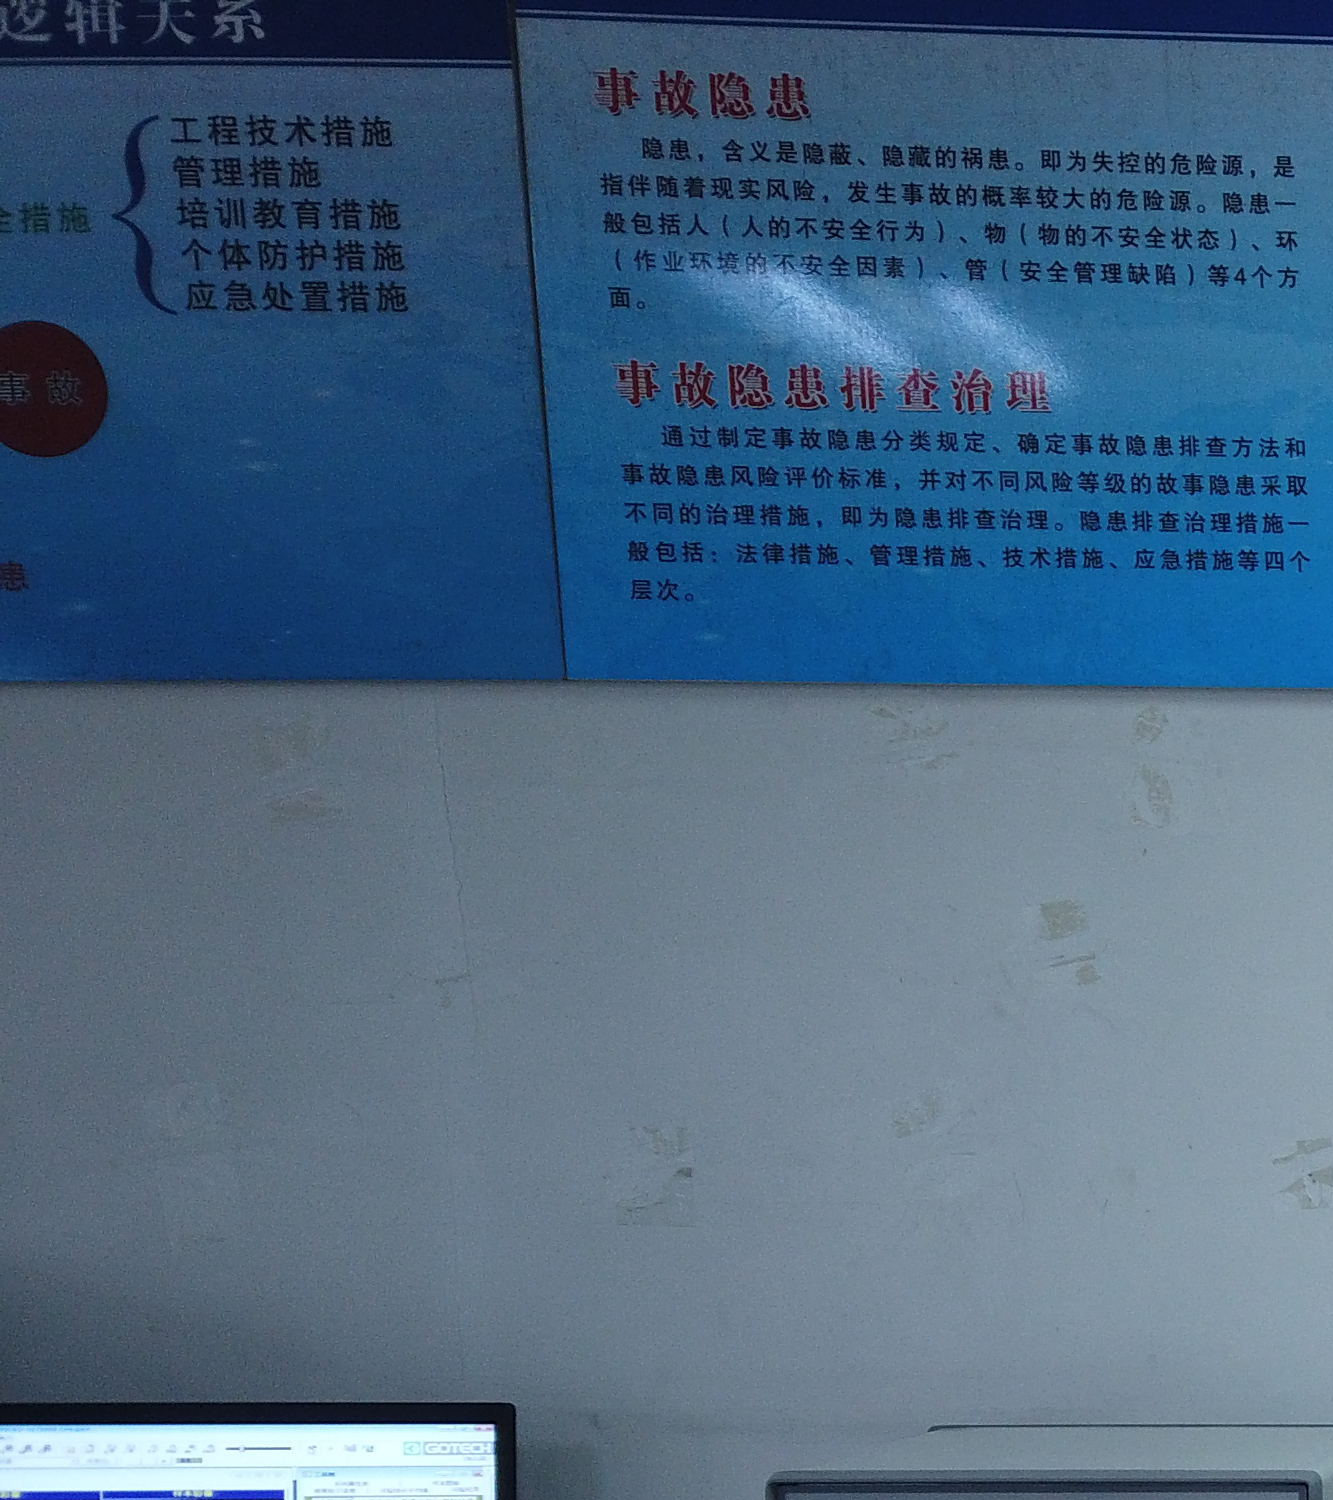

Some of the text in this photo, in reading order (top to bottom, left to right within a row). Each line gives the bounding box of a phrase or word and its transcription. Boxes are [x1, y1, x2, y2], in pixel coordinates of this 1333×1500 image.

[593, 66, 812, 121] 事故隐患
[171, 114, 394, 149] 工程技术措施
[172, 156, 322, 189] 管理措施
[178, 197, 402, 231] 培训教育措施
[181, 240, 406, 273] 个体防护措施
[185, 280, 410, 315] 应急处置措施
[608, 285, 648, 311] 面。
[0, 370, 84, 406] 事故
[614, 359, 1052, 414] 事故隐患排查治理
[660, 424, 1308, 461] 通过制定事故隐患分类规定、确定事故隐患排查方法和
[630, 578, 696, 604] 层次。
[424, 1442, 493, 1454] GOTECH
